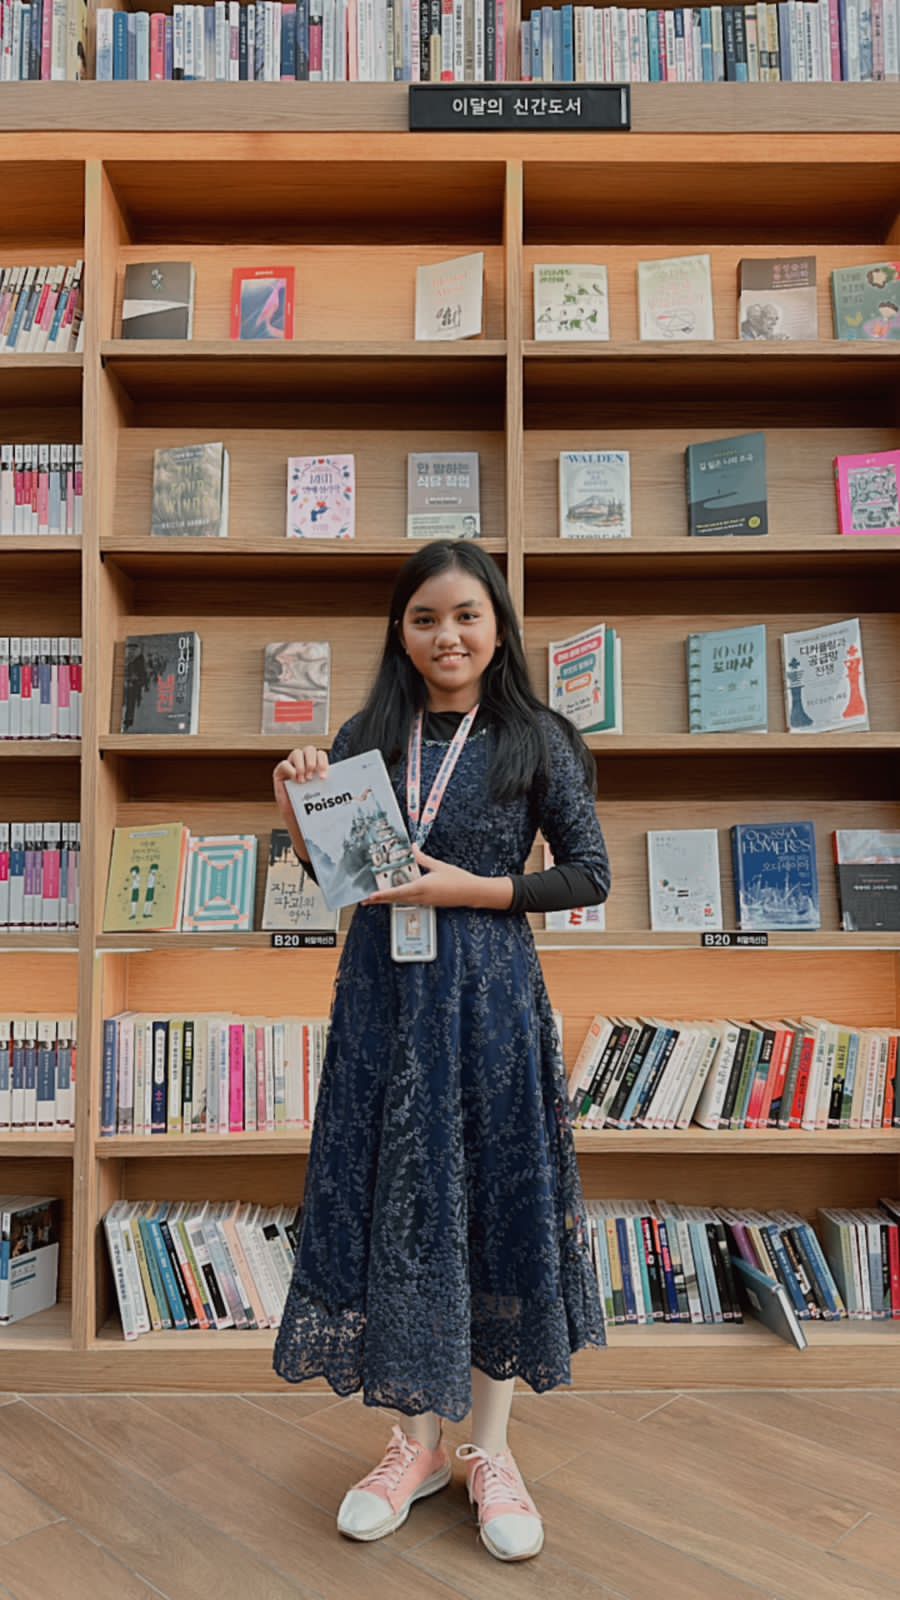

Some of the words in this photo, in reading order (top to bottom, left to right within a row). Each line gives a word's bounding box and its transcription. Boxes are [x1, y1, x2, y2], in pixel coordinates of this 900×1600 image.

[452, 97, 503, 116] 이달의
[513, 97, 582, 116] 신간도서
[566, 454, 625, 464] WALDEN
[304, 792, 352, 815] Poison
[271, 882, 297, 896] 지구
[274, 934, 300, 946] B20
[704, 934, 731, 946] B20
